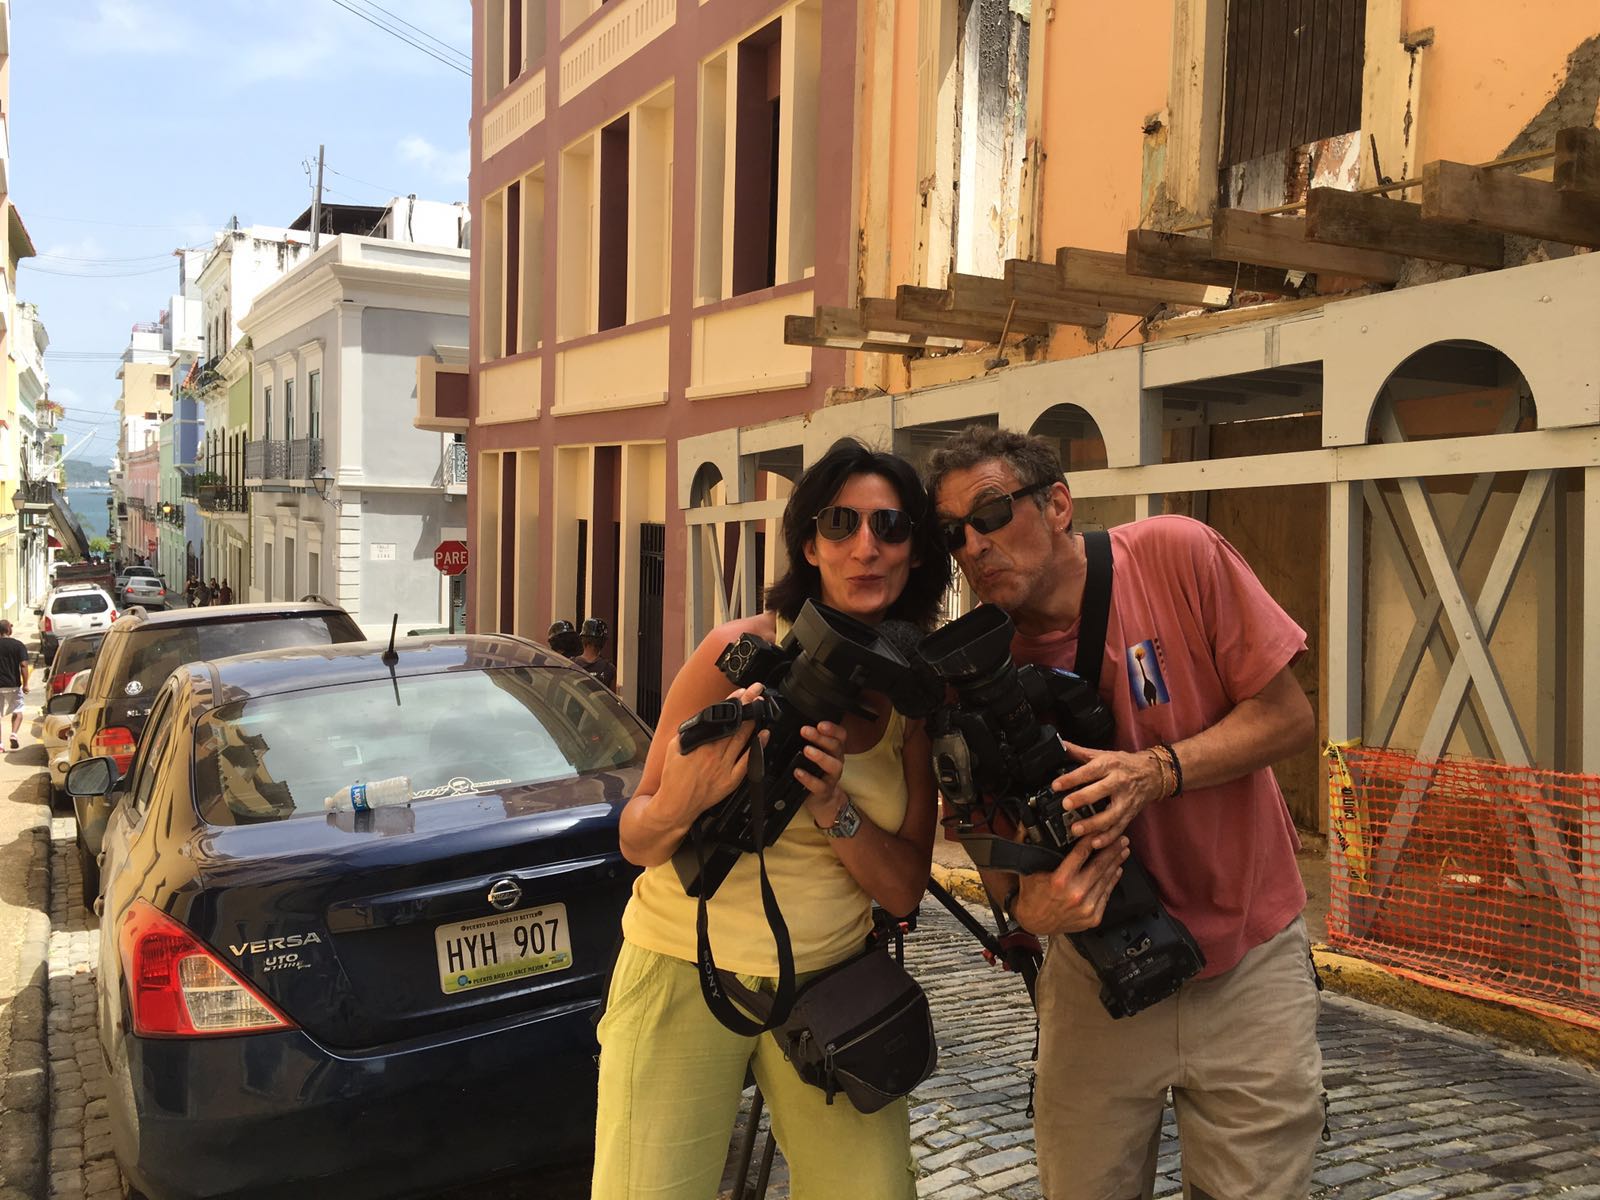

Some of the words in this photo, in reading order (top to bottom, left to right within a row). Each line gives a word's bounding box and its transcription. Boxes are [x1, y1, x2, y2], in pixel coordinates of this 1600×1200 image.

[435, 551, 468, 565] PARE
[1341, 787, 1357, 820] CAUTIO
[486, 919, 499, 927] RICO
[229, 931, 322, 957] VERSA
[446, 931, 498, 973] HYH
[513, 918, 559, 958] 907
